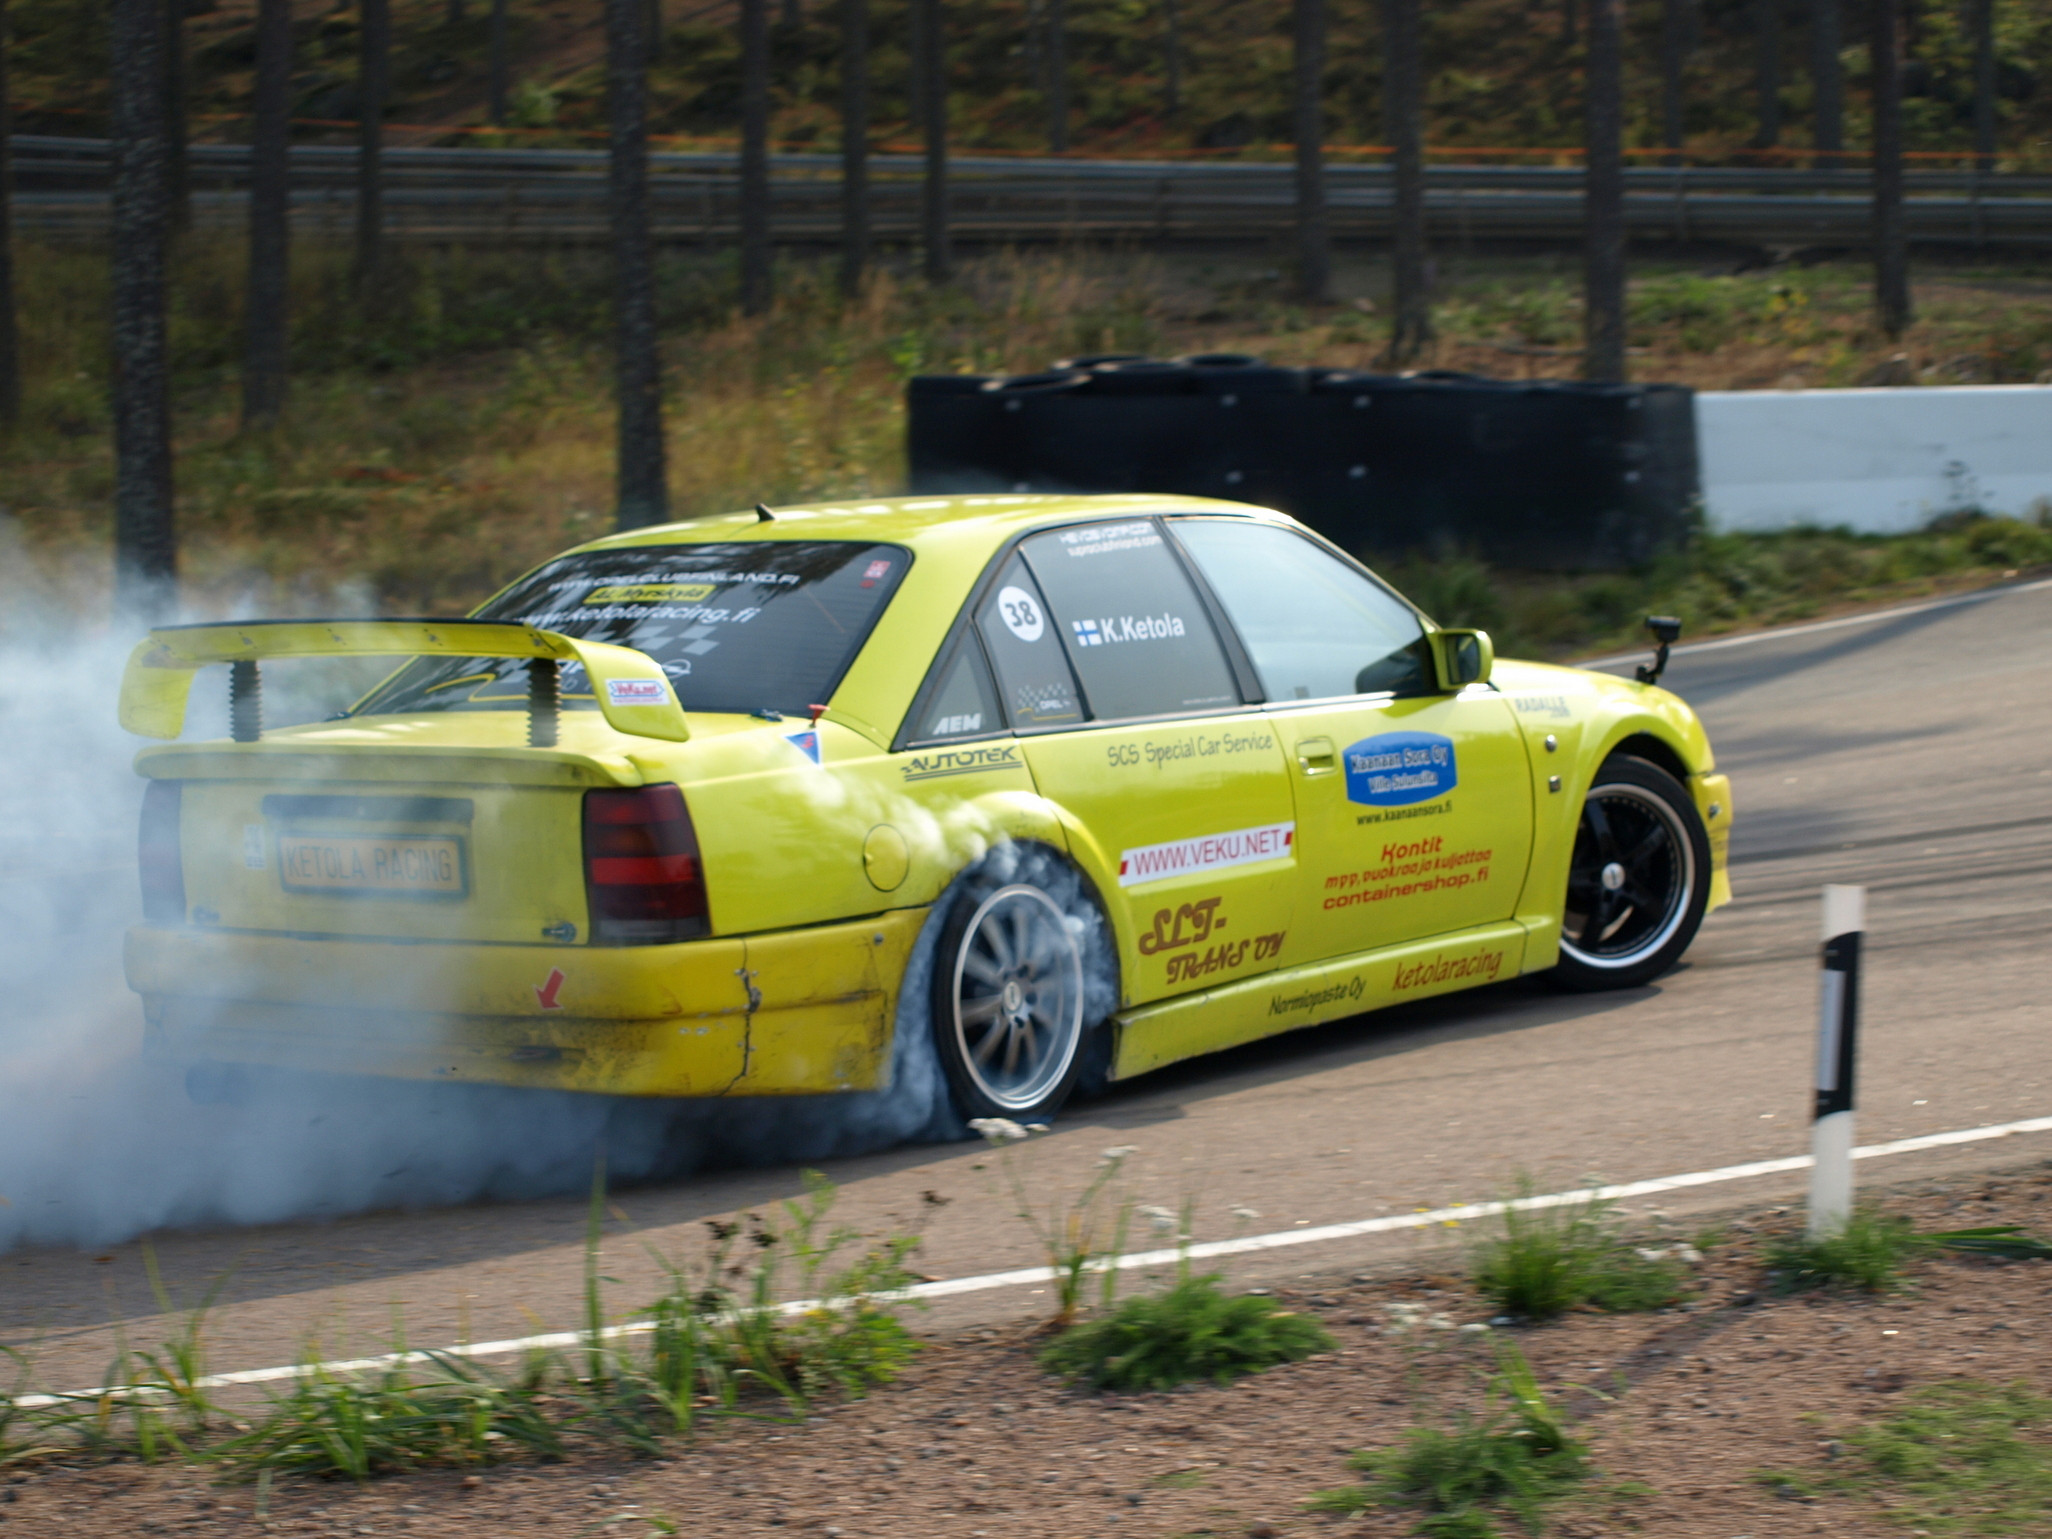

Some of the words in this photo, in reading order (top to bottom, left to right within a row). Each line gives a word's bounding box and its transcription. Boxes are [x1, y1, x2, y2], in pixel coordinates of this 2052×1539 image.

[1005, 601, 1036, 627] 38
[1101, 613, 1185, 643] K.Ketola
[933, 713, 981, 735] AEM
[907, 746, 1016, 771] AUTOTEK
[1108, 744, 1140, 767] SCS
[1145, 738, 1195, 769] Special
[1198, 736, 1221, 757] Car
[1223, 731, 1272, 753] Service
[1350, 753, 1402, 774] Kaanaan
[1403, 747, 1431, 768] Sora
[1432, 744, 1448, 767] Oy
[1357, 800, 1452, 825] www.kaanaansora.fi
[286, 845, 366, 879] KETOLA
[373, 848, 452, 882] RACING
[1134, 828, 1281, 875] WWW.VEKU.NET
[1381, 835, 1443, 863] Kontit
[1323, 866, 1489, 910] containershop.fi
[1166, 939, 1251, 985] TRANS
[1392, 948, 1503, 991] ketolaracing
[1349, 976, 1367, 1000] Oy
